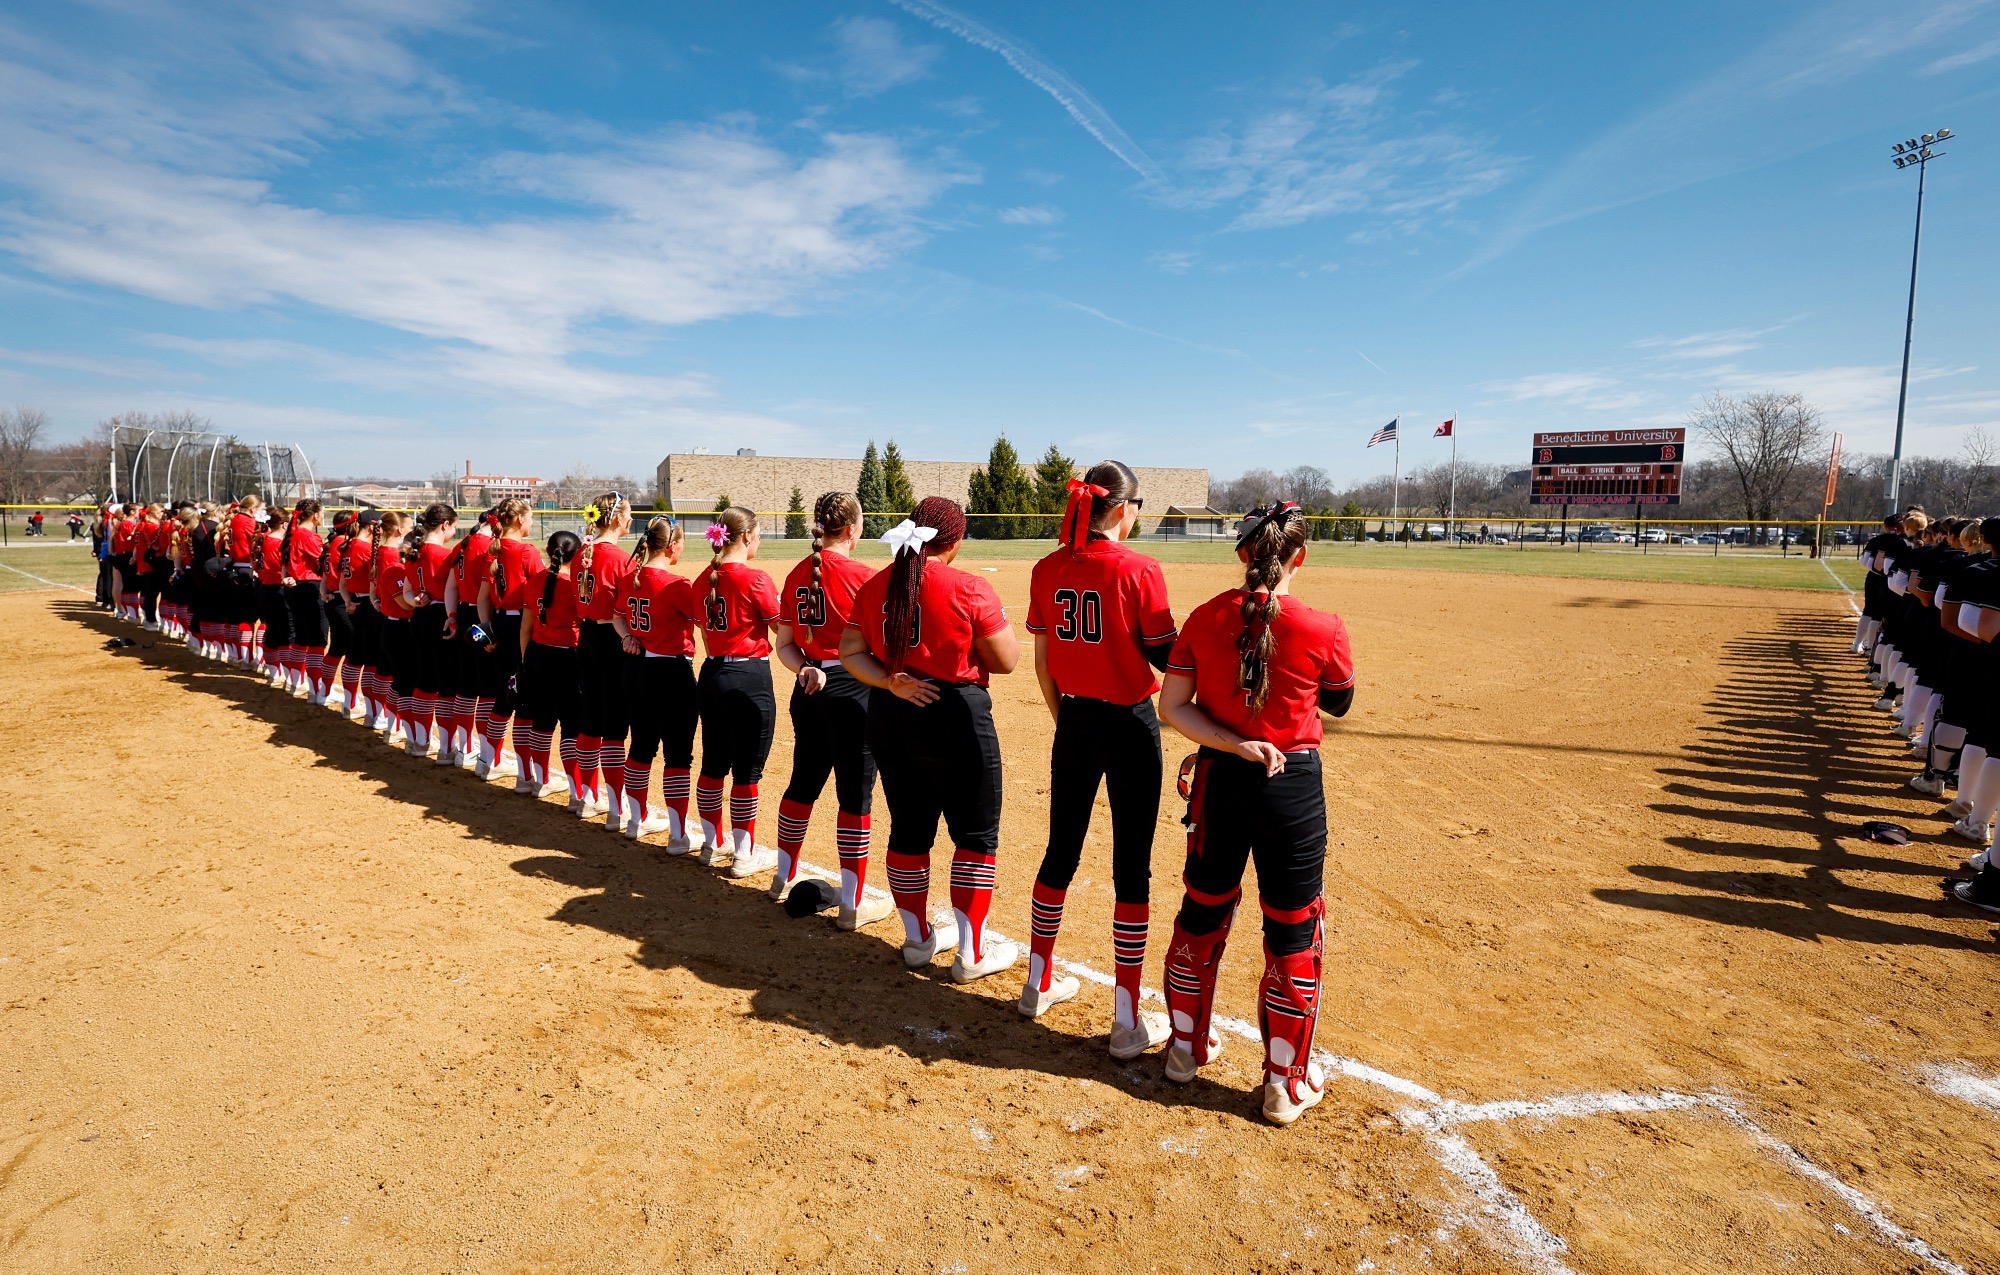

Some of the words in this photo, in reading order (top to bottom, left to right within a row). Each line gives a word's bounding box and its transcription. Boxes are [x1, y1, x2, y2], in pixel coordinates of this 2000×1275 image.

[1541, 431, 1609, 444] Benedictine
[1615, 430, 1677, 443] University
[1539, 448, 1553, 463] B
[1661, 445, 1676, 460] B
[417, 567, 425, 591] 1
[627, 597, 650, 632] 35
[796, 586, 827, 626] 20
[1055, 588, 1103, 644] 30
